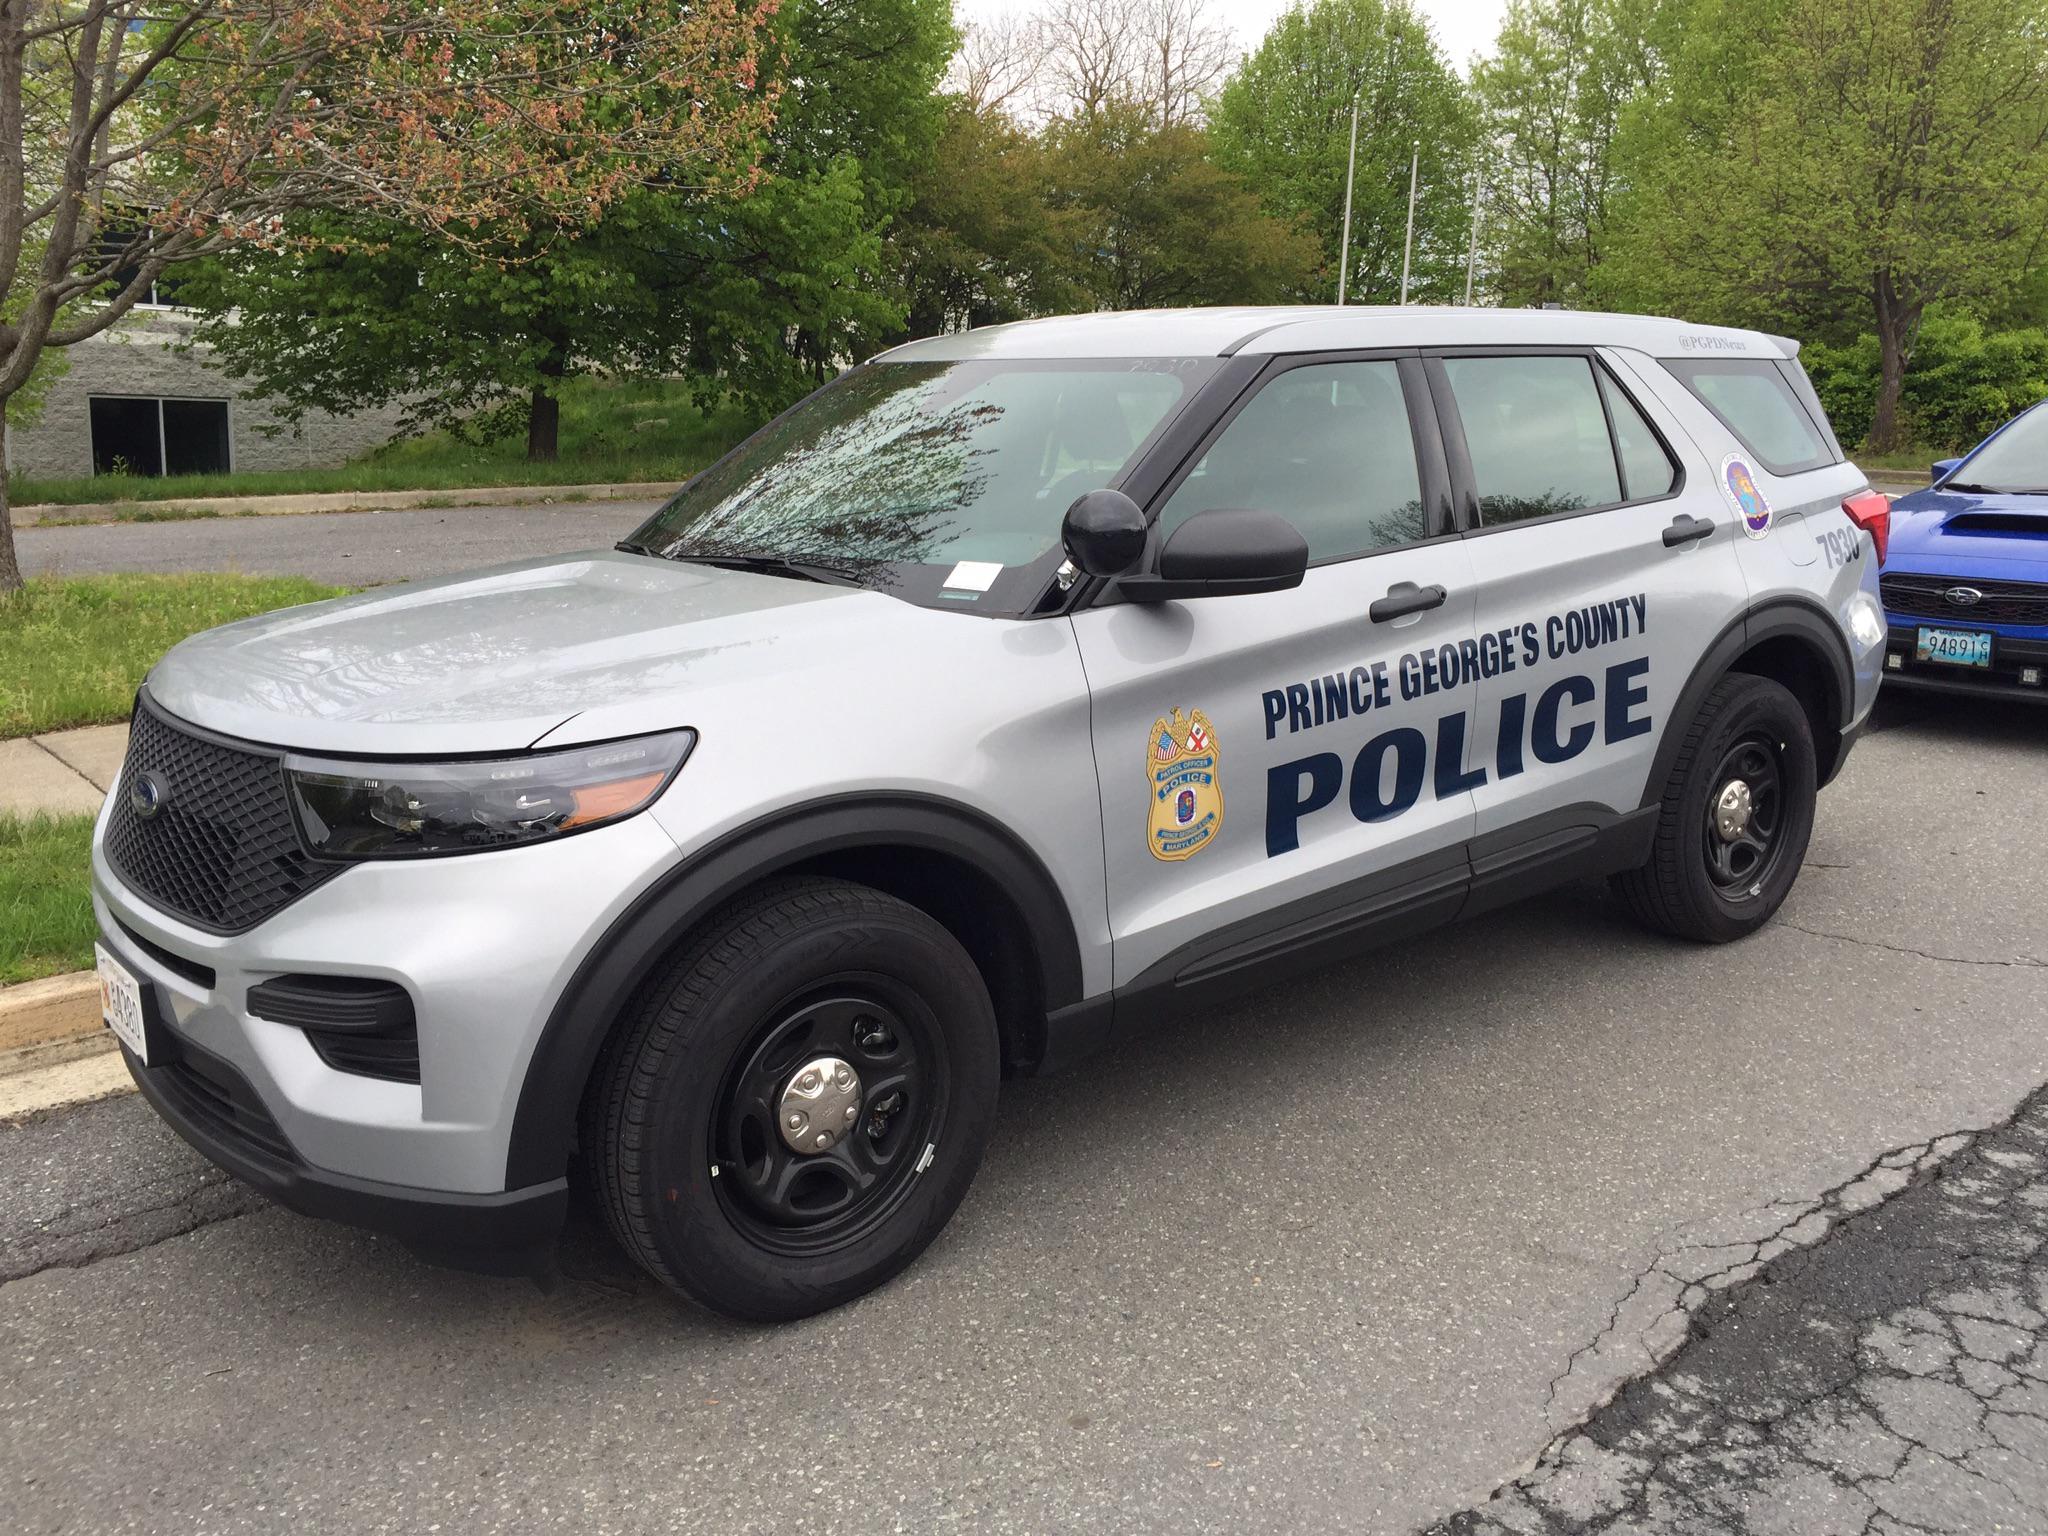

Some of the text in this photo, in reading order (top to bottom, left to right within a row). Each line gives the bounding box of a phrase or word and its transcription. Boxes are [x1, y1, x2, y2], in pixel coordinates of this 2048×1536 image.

[1679, 335, 1746, 351] @PGPDNews
[1815, 525, 1860, 569] 7930
[1929, 636, 1975, 658] 94891
[1262, 593, 1647, 740] PRINCE GEORGE'S COUNTY
[1265, 656, 1652, 859] POLICE
[1163, 773, 1207, 794] POLICE
[1166, 831, 1205, 850] MARYLAND
